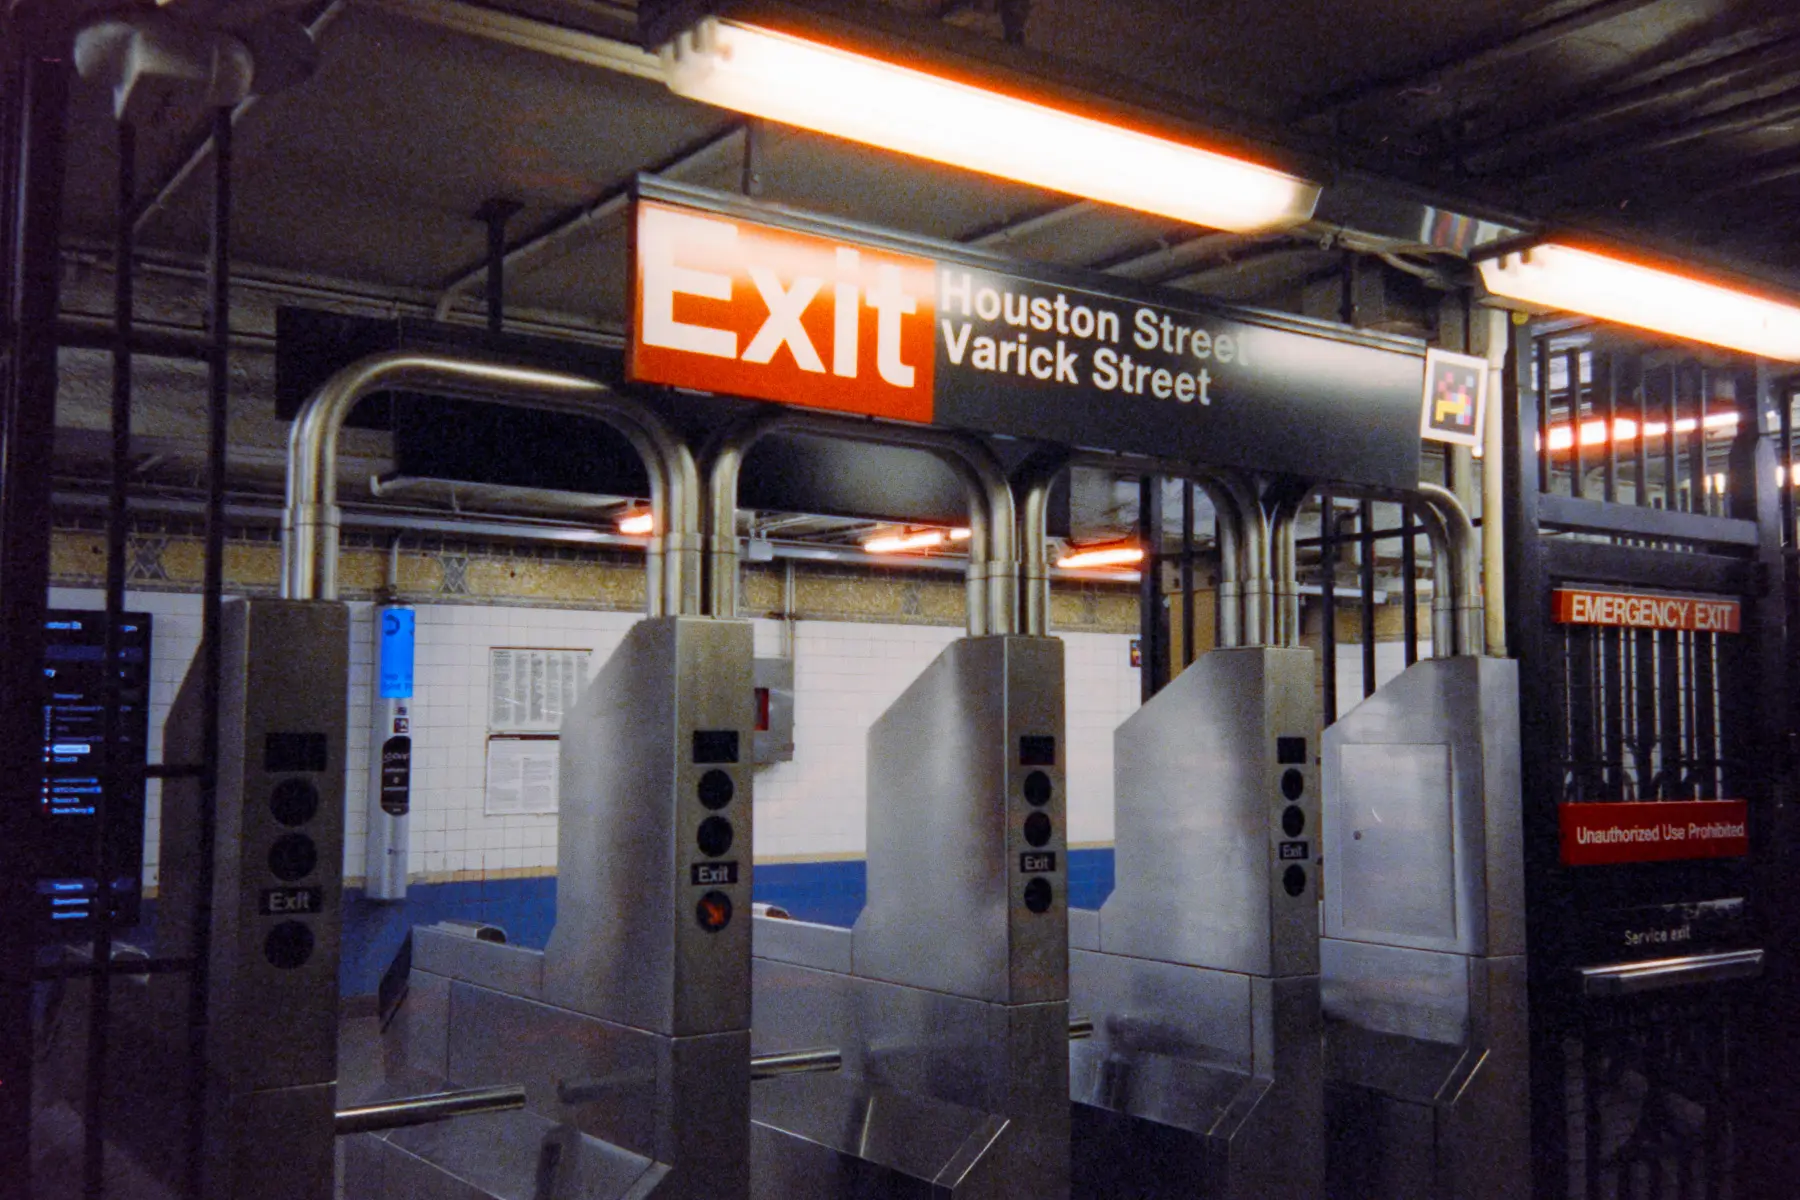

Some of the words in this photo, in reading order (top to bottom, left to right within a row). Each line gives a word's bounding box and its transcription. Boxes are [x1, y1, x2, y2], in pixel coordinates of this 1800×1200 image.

[642, 206, 917, 388] Exit
[940, 270, 1120, 343] Houston
[1133, 308, 1248, 366] Street
[941, 319, 1079, 385] Varick
[1092, 348, 1211, 405] Street
[1572, 594, 1689, 627] EMERGENCY
[1695, 603, 1733, 630] EXIT
[1577, 824, 1659, 844] Unauthorized
[1662, 824, 1686, 841] Use
[1688, 822, 1745, 839] Prohibited
[699, 865, 728, 882] Exit
[1025, 856, 1048, 870] Exit
[270, 891, 308, 911] Exit
[1625, 928, 1668, 945] Service
[1671, 925, 1691, 940] exit
